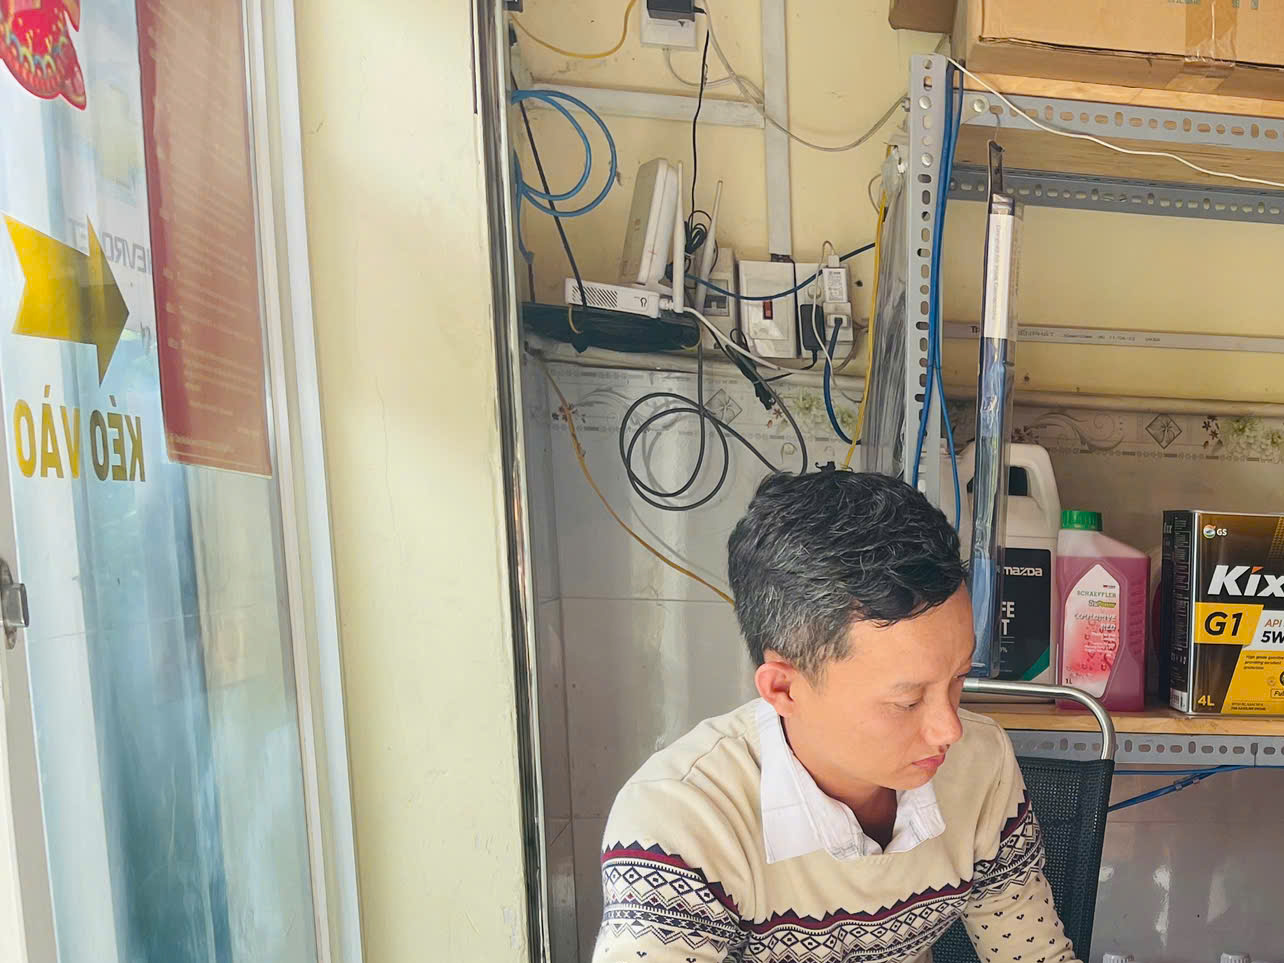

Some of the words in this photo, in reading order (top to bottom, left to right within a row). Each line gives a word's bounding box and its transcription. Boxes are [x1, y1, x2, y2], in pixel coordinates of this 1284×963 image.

[1217, 528, 1228, 536] GS
[1204, 611, 1243, 637] G1
[1264, 619, 1282, 627] API
[1198, 695, 1215, 707] 4L
